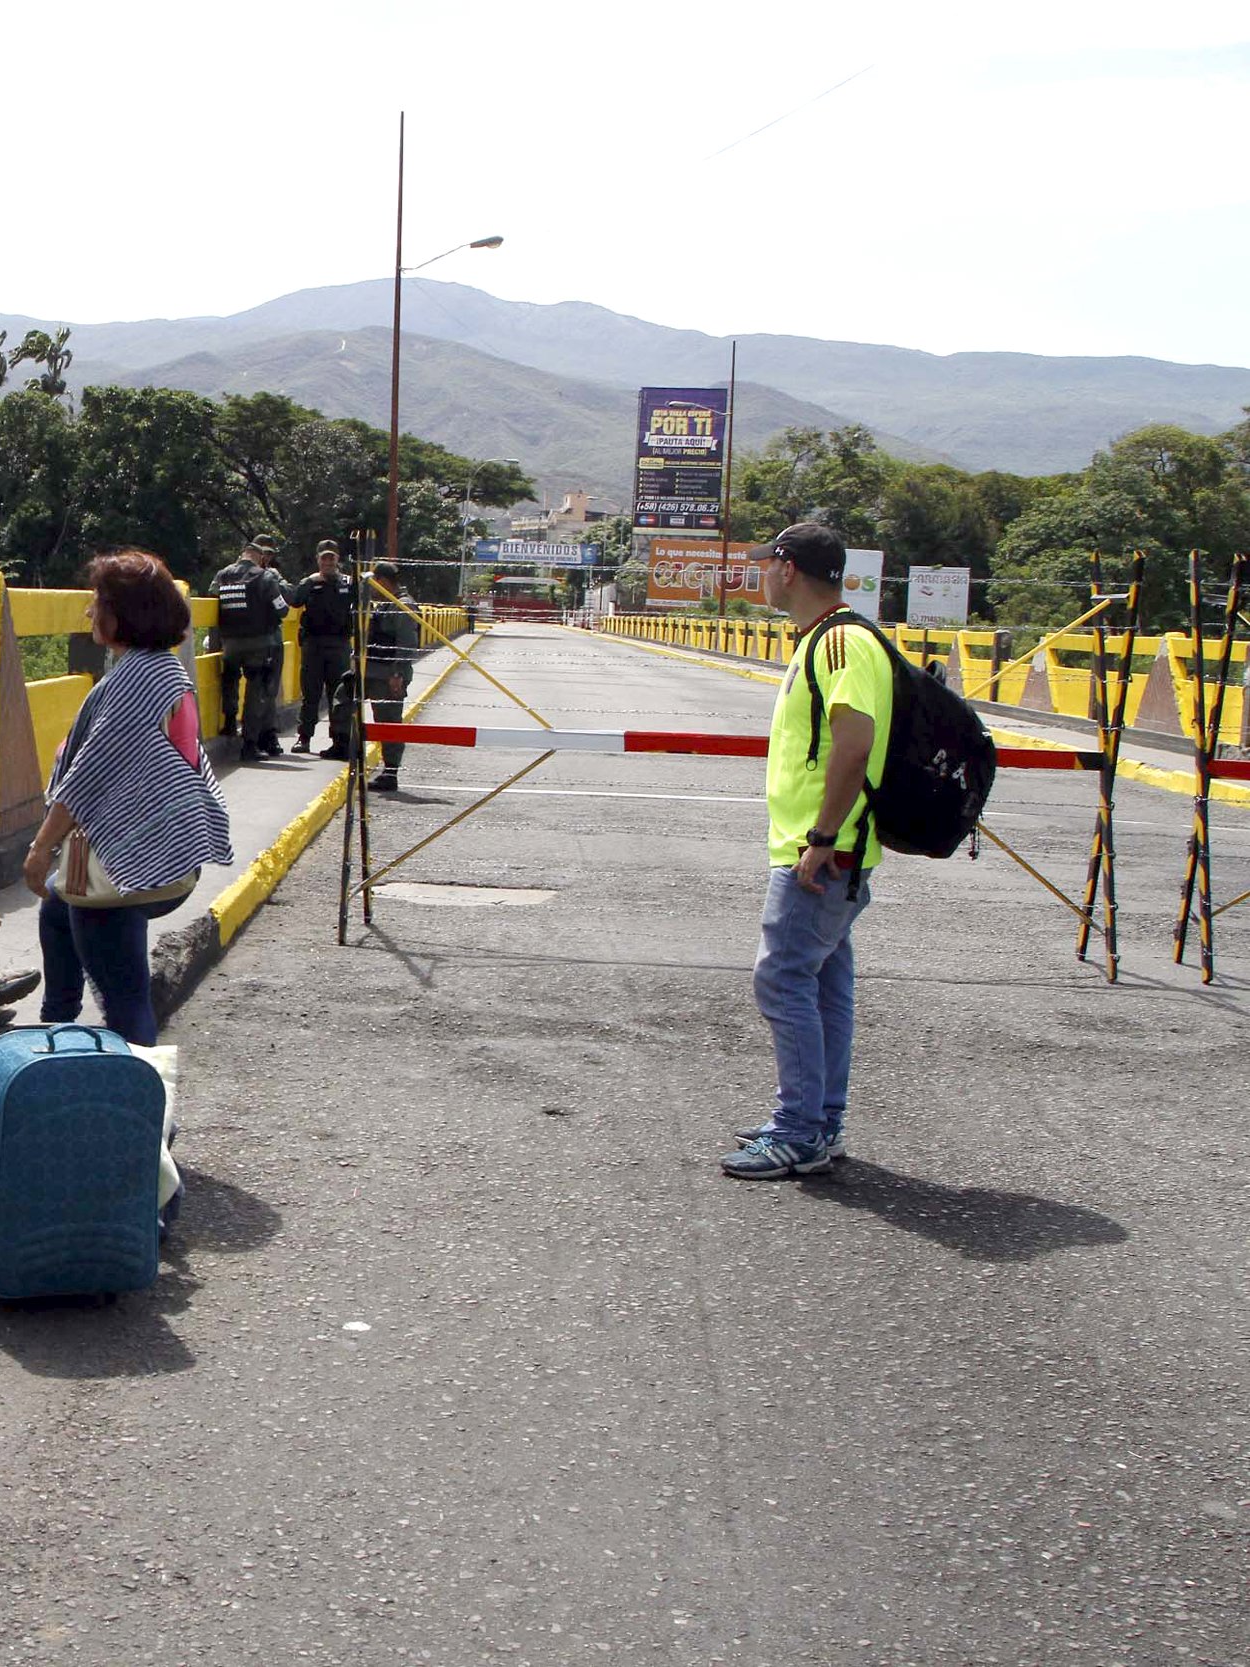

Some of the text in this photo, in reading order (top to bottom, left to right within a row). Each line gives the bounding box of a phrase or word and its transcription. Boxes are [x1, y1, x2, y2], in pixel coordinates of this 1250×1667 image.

[650, 416, 713, 436] POR TI
[636, 502, 658, 512] (+58)
[502, 541, 578, 556] BIENVENIDOS
[655, 547, 666, 556] Lo
[667, 549, 684, 558] que
